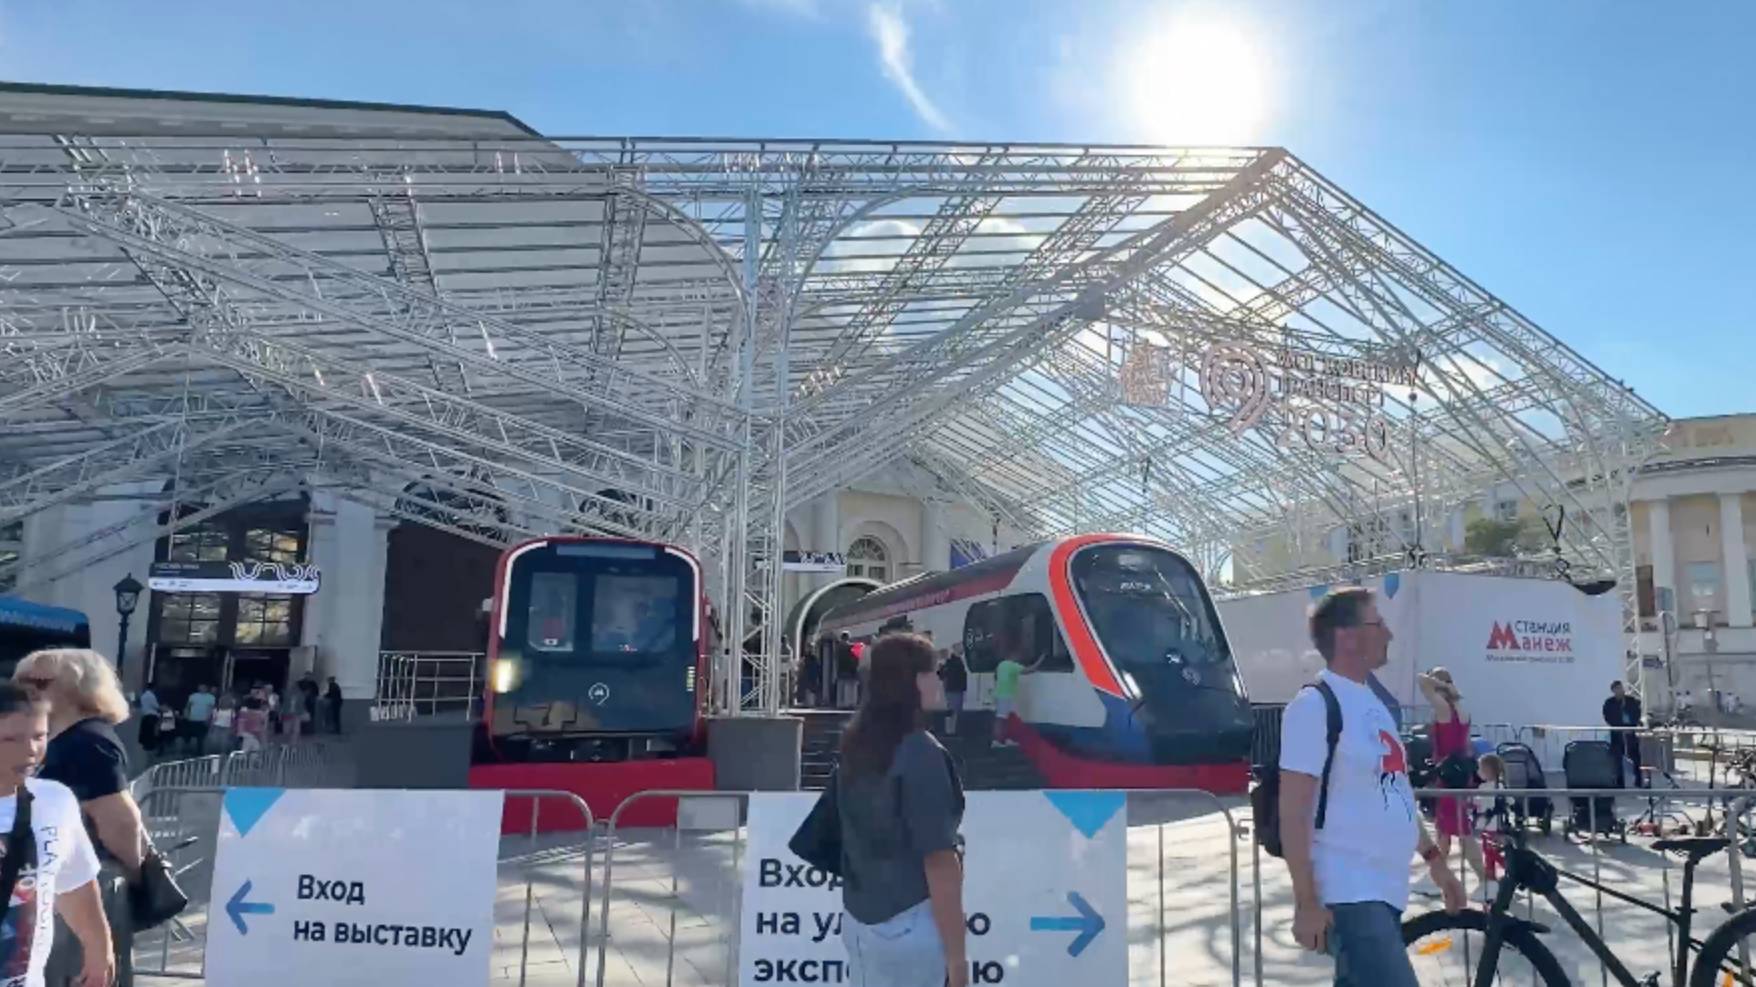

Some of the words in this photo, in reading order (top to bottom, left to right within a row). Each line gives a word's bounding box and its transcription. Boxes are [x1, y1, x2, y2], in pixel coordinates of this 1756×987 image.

[1486, 620, 1572, 652] Манеж
[297, 874, 365, 905] Вход
[293, 920, 326, 942] на
[334, 922, 472, 956] выставку
[756, 911, 800, 935] на
